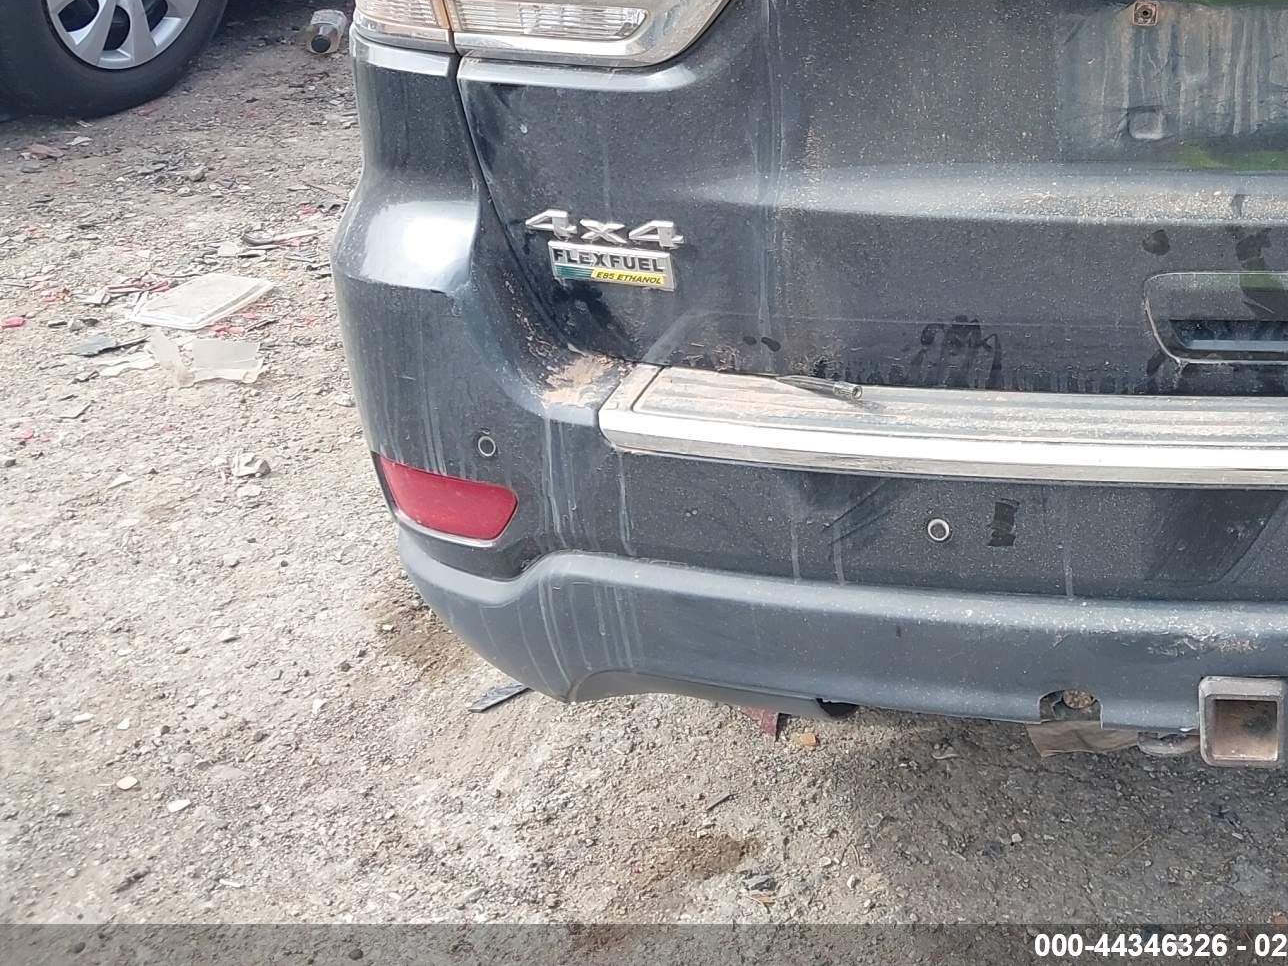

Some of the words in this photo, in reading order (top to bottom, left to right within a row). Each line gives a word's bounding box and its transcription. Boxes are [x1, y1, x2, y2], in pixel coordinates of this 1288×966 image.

[552, 248, 665, 273] FLEXFUEL
[596, 271, 616, 280] E85
[617, 273, 663, 284] ETHANOL
